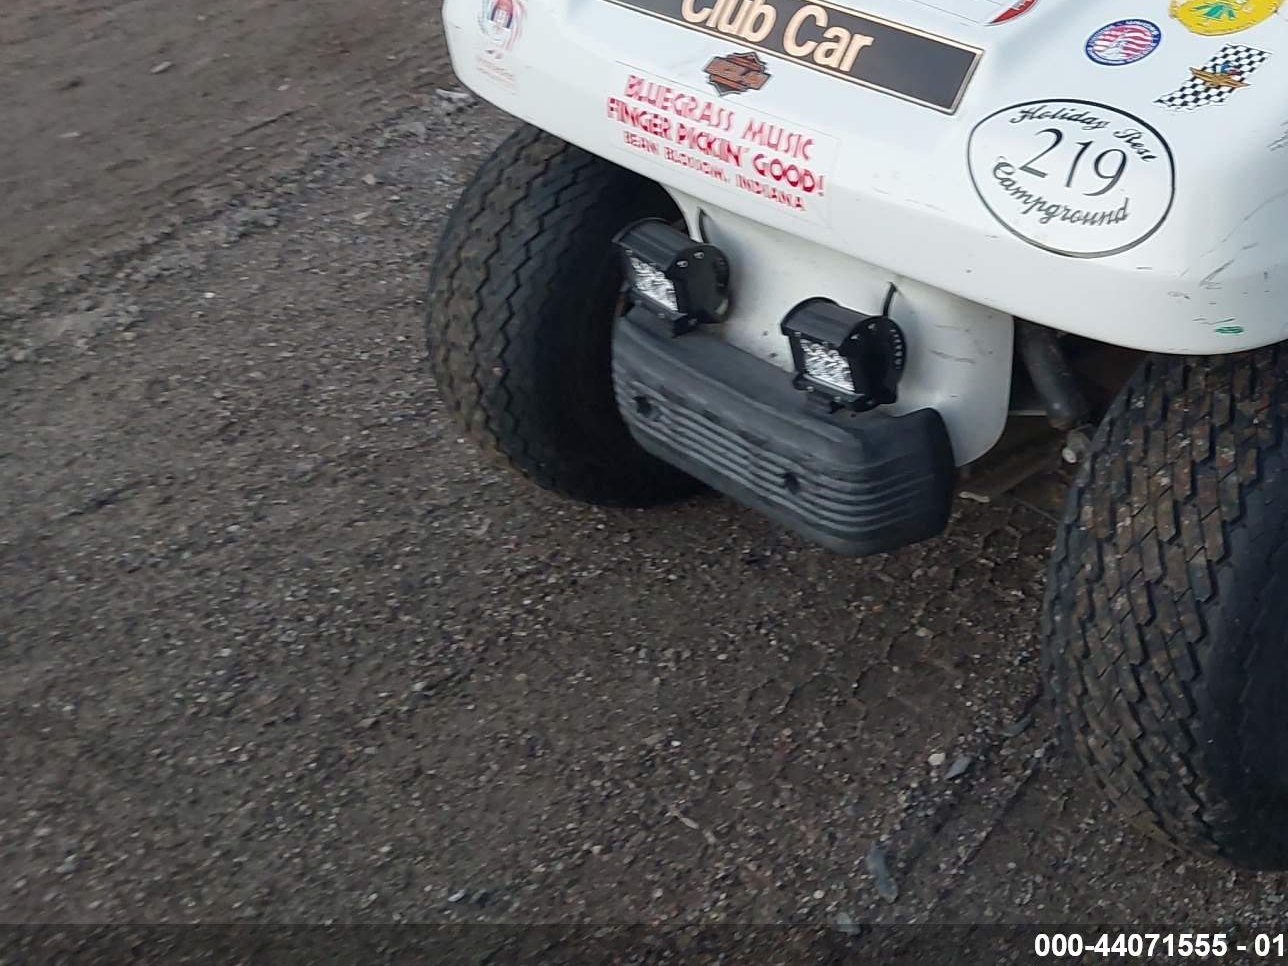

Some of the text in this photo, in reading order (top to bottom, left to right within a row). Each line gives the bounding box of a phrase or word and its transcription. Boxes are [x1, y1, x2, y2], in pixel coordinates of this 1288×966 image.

[783, 4, 874, 72] Car
[607, 96, 673, 140] FINGER
[752, 153, 825, 196] GOOD!
[624, 74, 816, 160] BLUEGRASS MUSIC
[1009, 105, 1110, 130] Holiday
[736, 174, 806, 211] INDIANA
[993, 155, 1130, 226] Campground
[1018, 128, 1127, 197] 219
